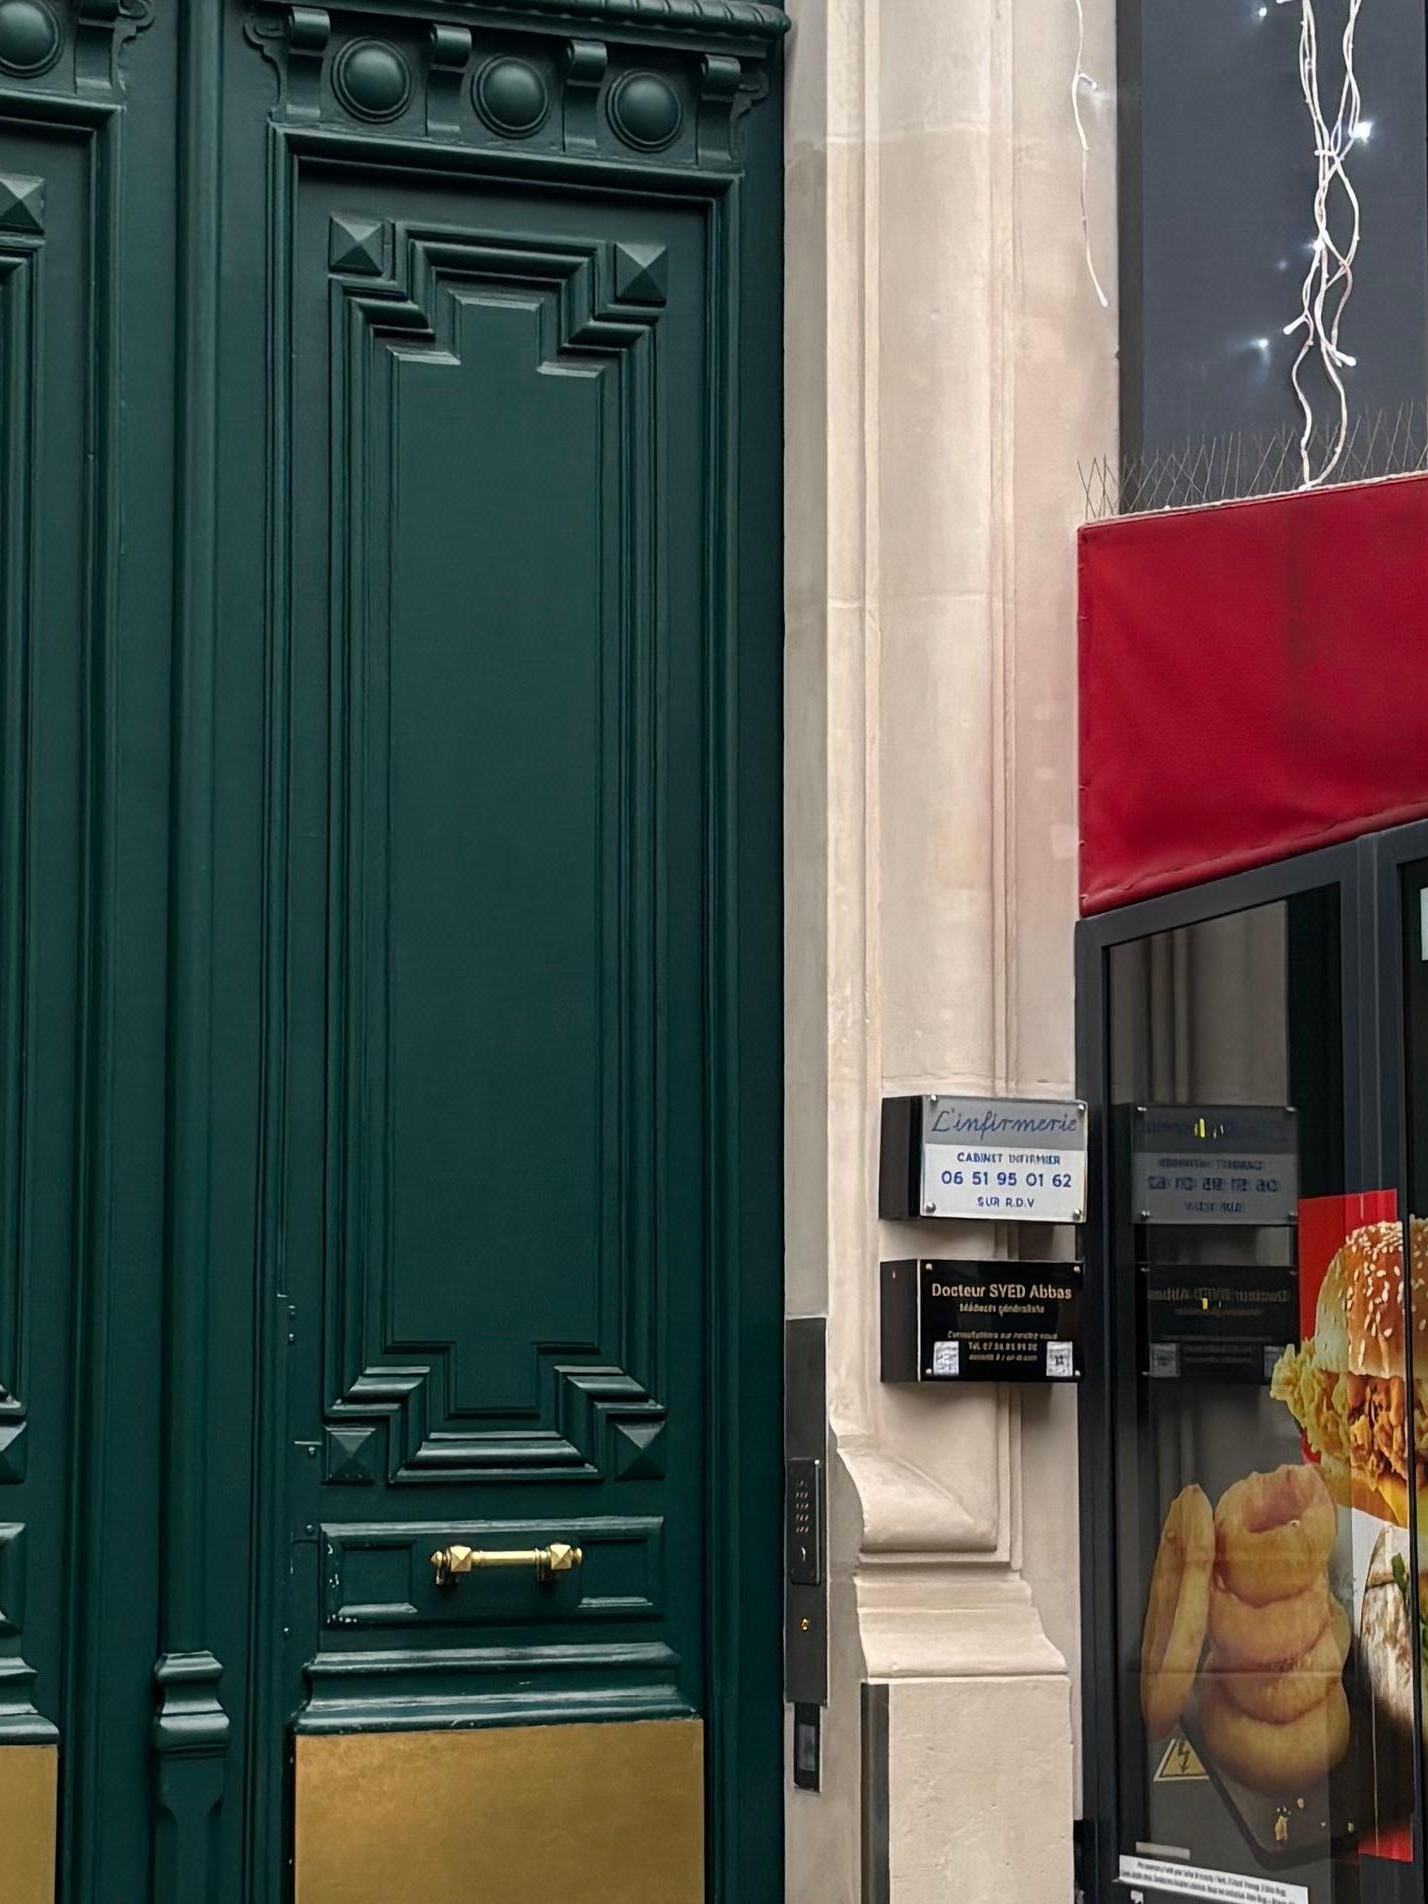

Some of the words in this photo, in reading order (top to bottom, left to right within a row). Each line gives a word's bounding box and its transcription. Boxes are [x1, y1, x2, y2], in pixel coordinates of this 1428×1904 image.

[931, 1108, 1078, 1142] L'infirmerie
[957, 1152, 1003, 1164] CABINET
[941, 1170, 963, 1185] 06
[972, 1171, 989, 1186] 51
[997, 1172, 1017, 1187] 95
[1026, 1173, 1044, 1187] 01
[1052, 1173, 1072, 1189] 62
[977, 1196, 1000, 1207] SUR
[932, 1283, 986, 1297] Docteur
[989, 1283, 1026, 1299] SYED
[1029, 1284, 1072, 1300] Abbas
